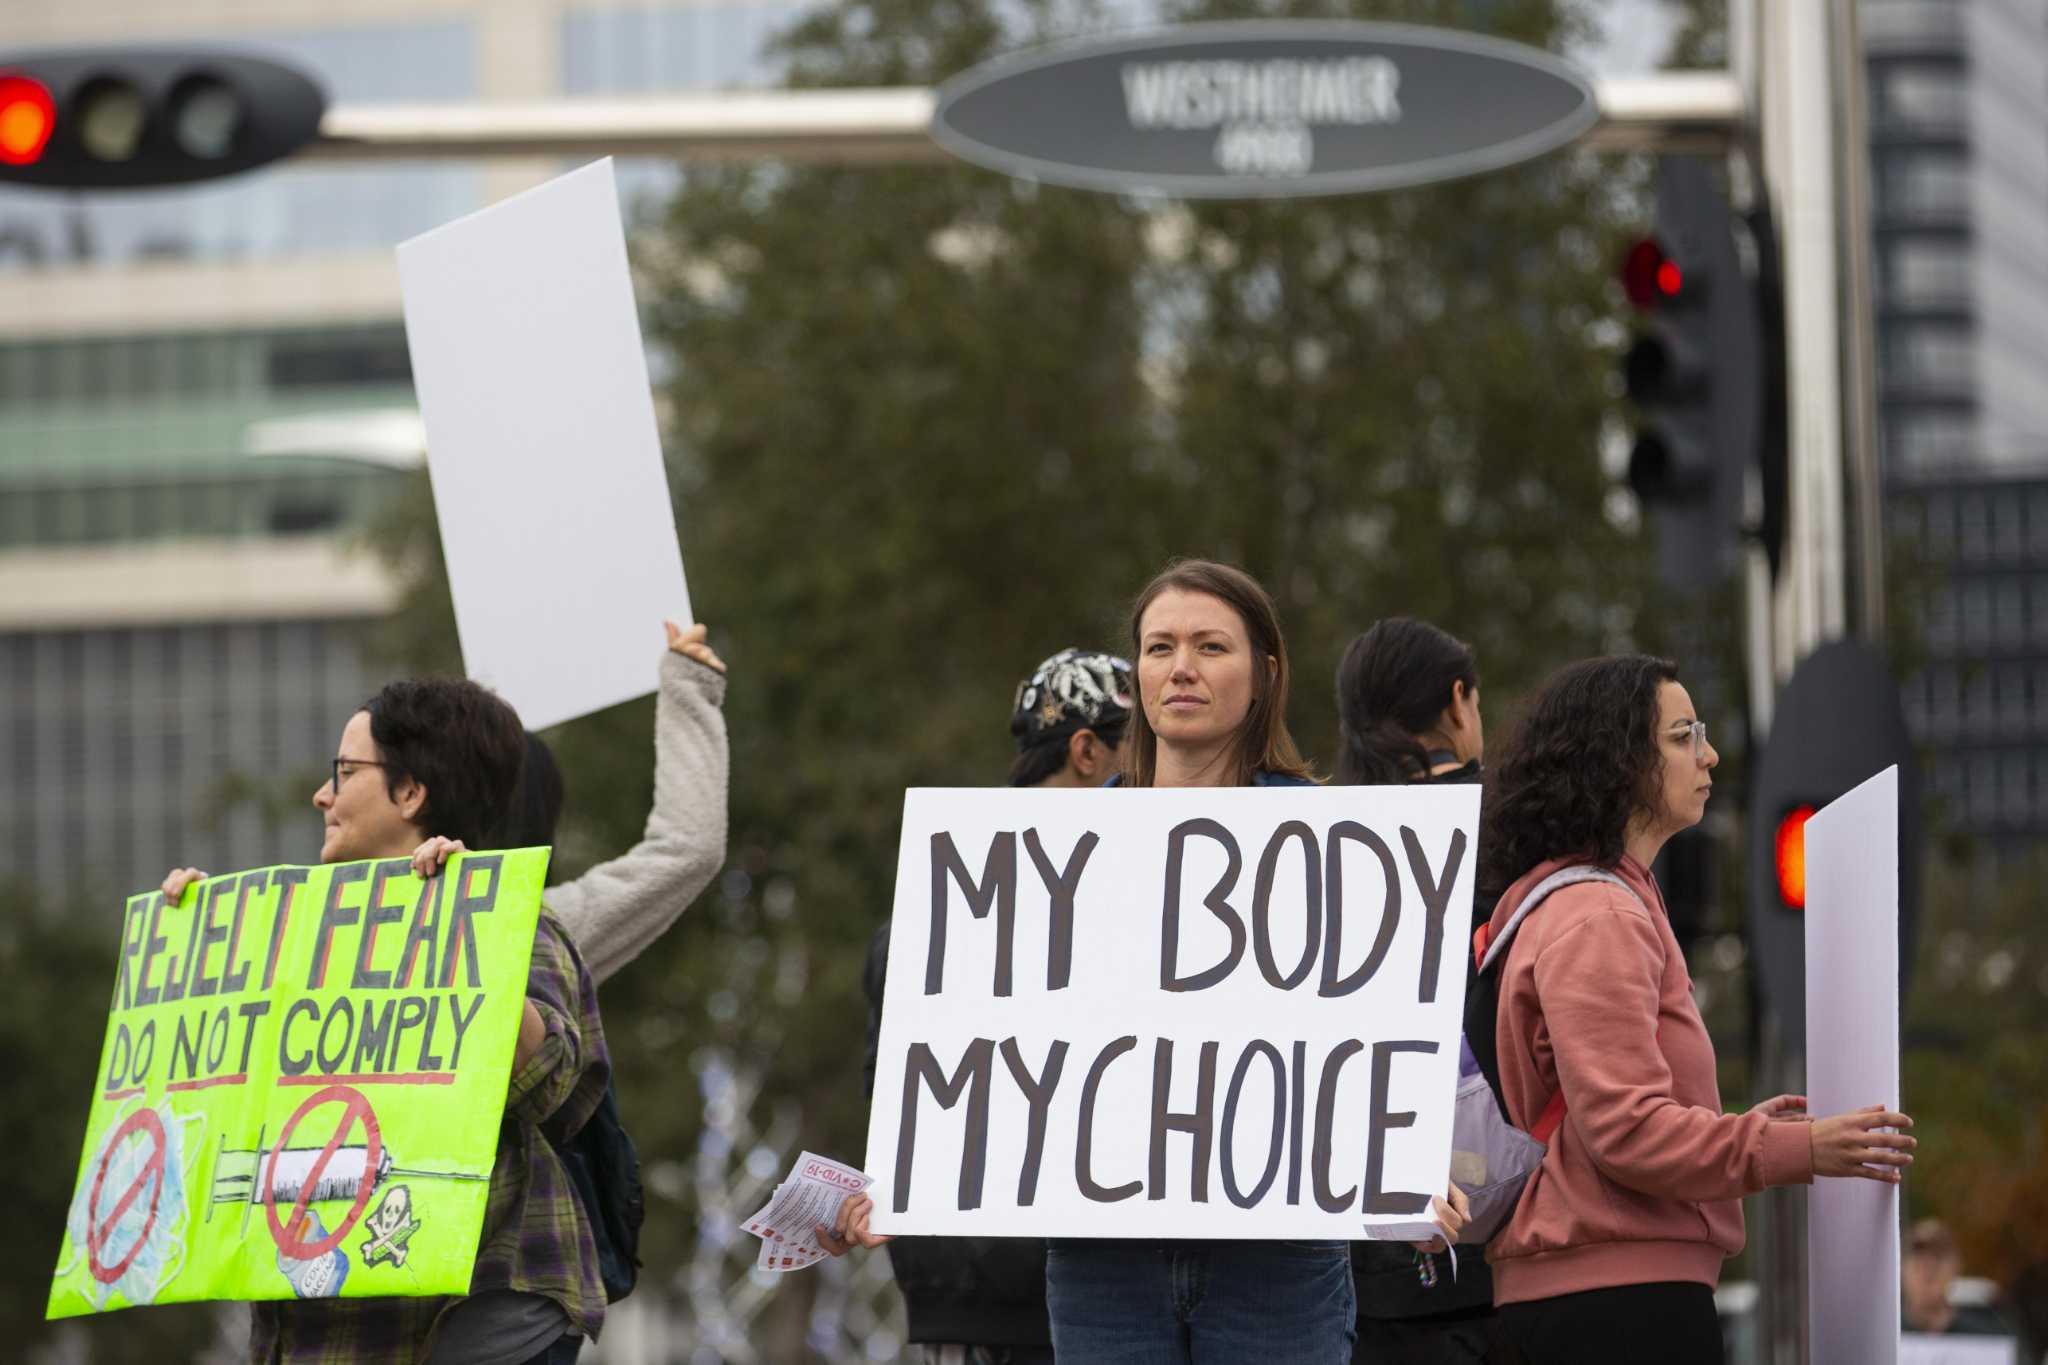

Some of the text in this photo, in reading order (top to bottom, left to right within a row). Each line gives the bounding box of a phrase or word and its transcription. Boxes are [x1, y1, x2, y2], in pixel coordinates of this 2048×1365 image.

[1122, 57, 1402, 128] WESTHEIMER
[112, 855, 504, 1012] REJECT FEAR
[924, 818, 1467, 1003] MY BODY
[106, 993, 485, 1091] DO NOT COMPLY
